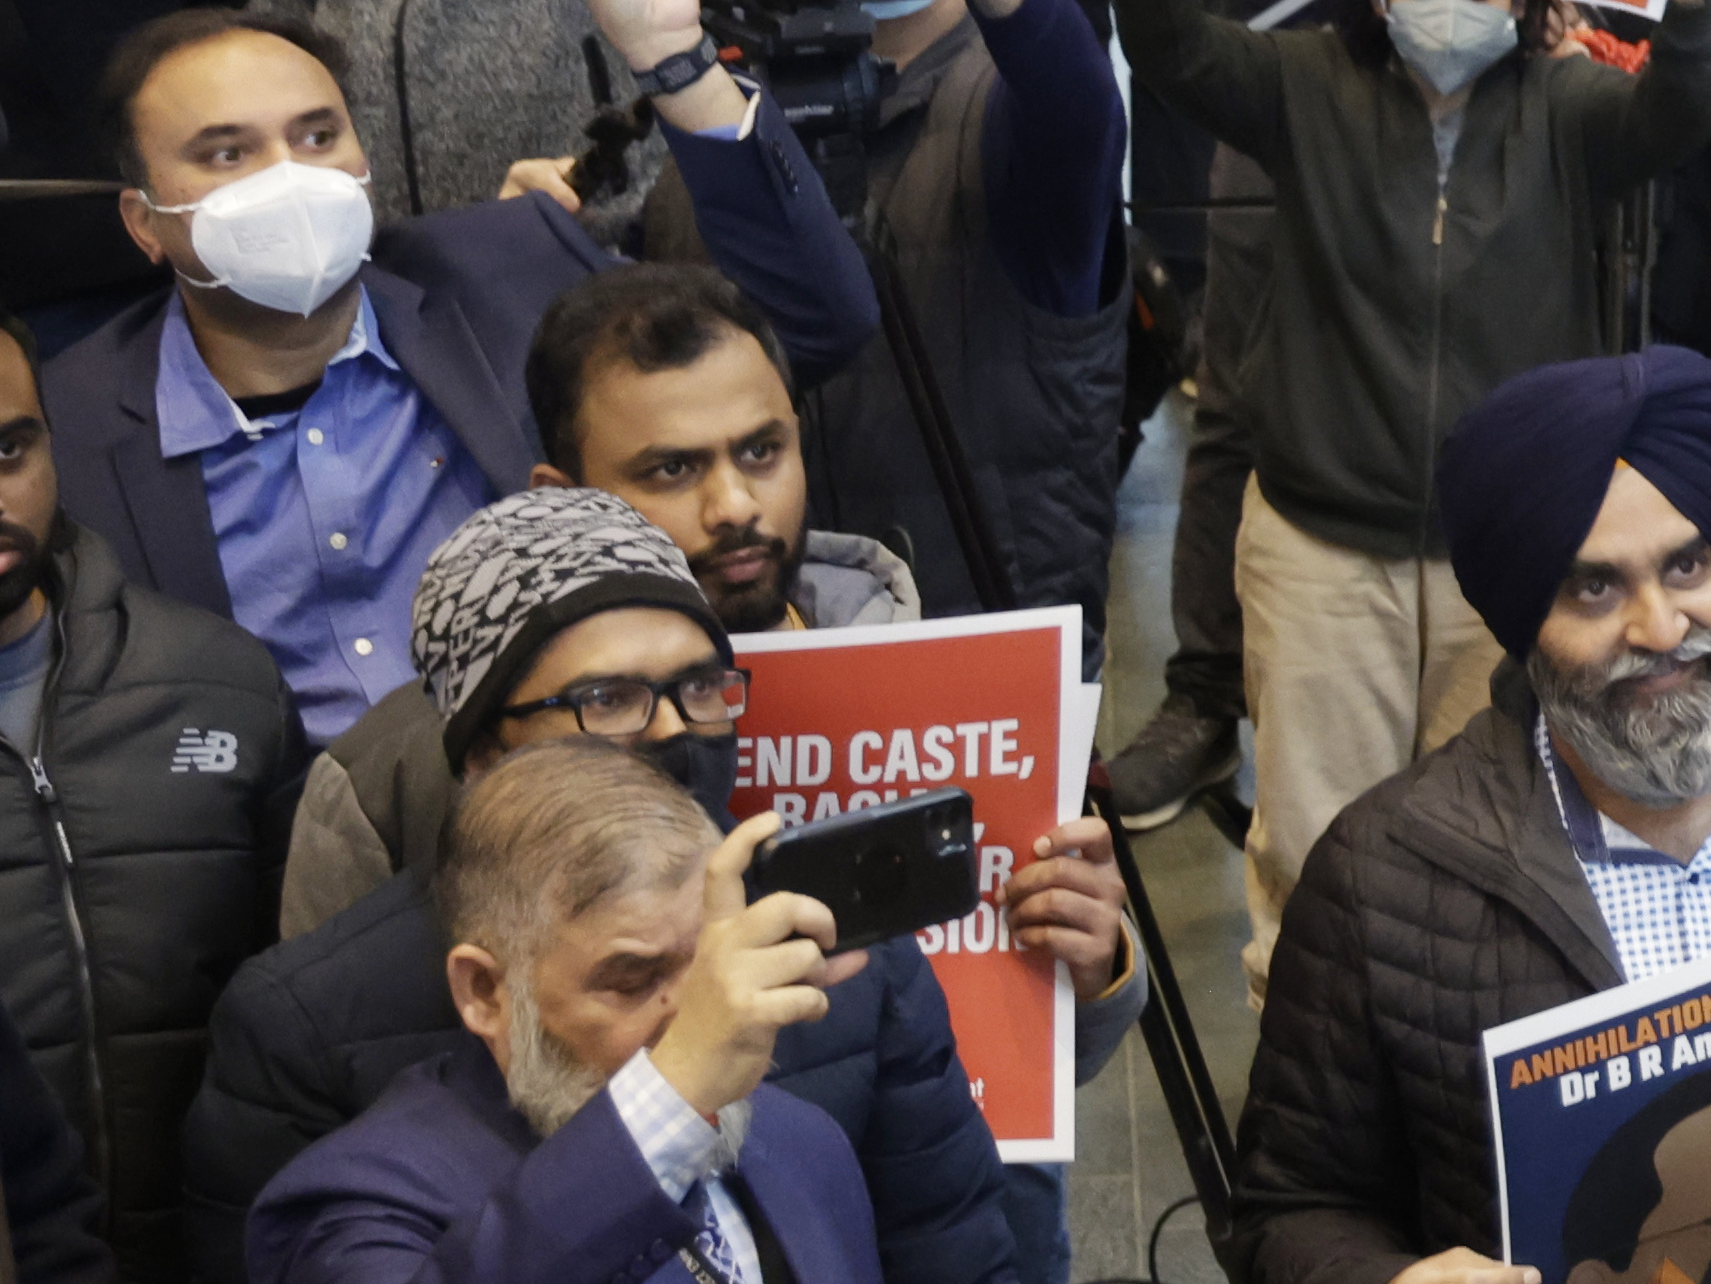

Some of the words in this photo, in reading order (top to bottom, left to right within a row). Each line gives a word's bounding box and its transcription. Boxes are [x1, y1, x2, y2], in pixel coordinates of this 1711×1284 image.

[735, 734, 831, 787] END
[849, 718, 1035, 785] CASTE,
[1560, 1067, 1600, 1108] Dr
[1606, 1054, 1632, 1094] B
[1638, 1045, 1665, 1082] R
